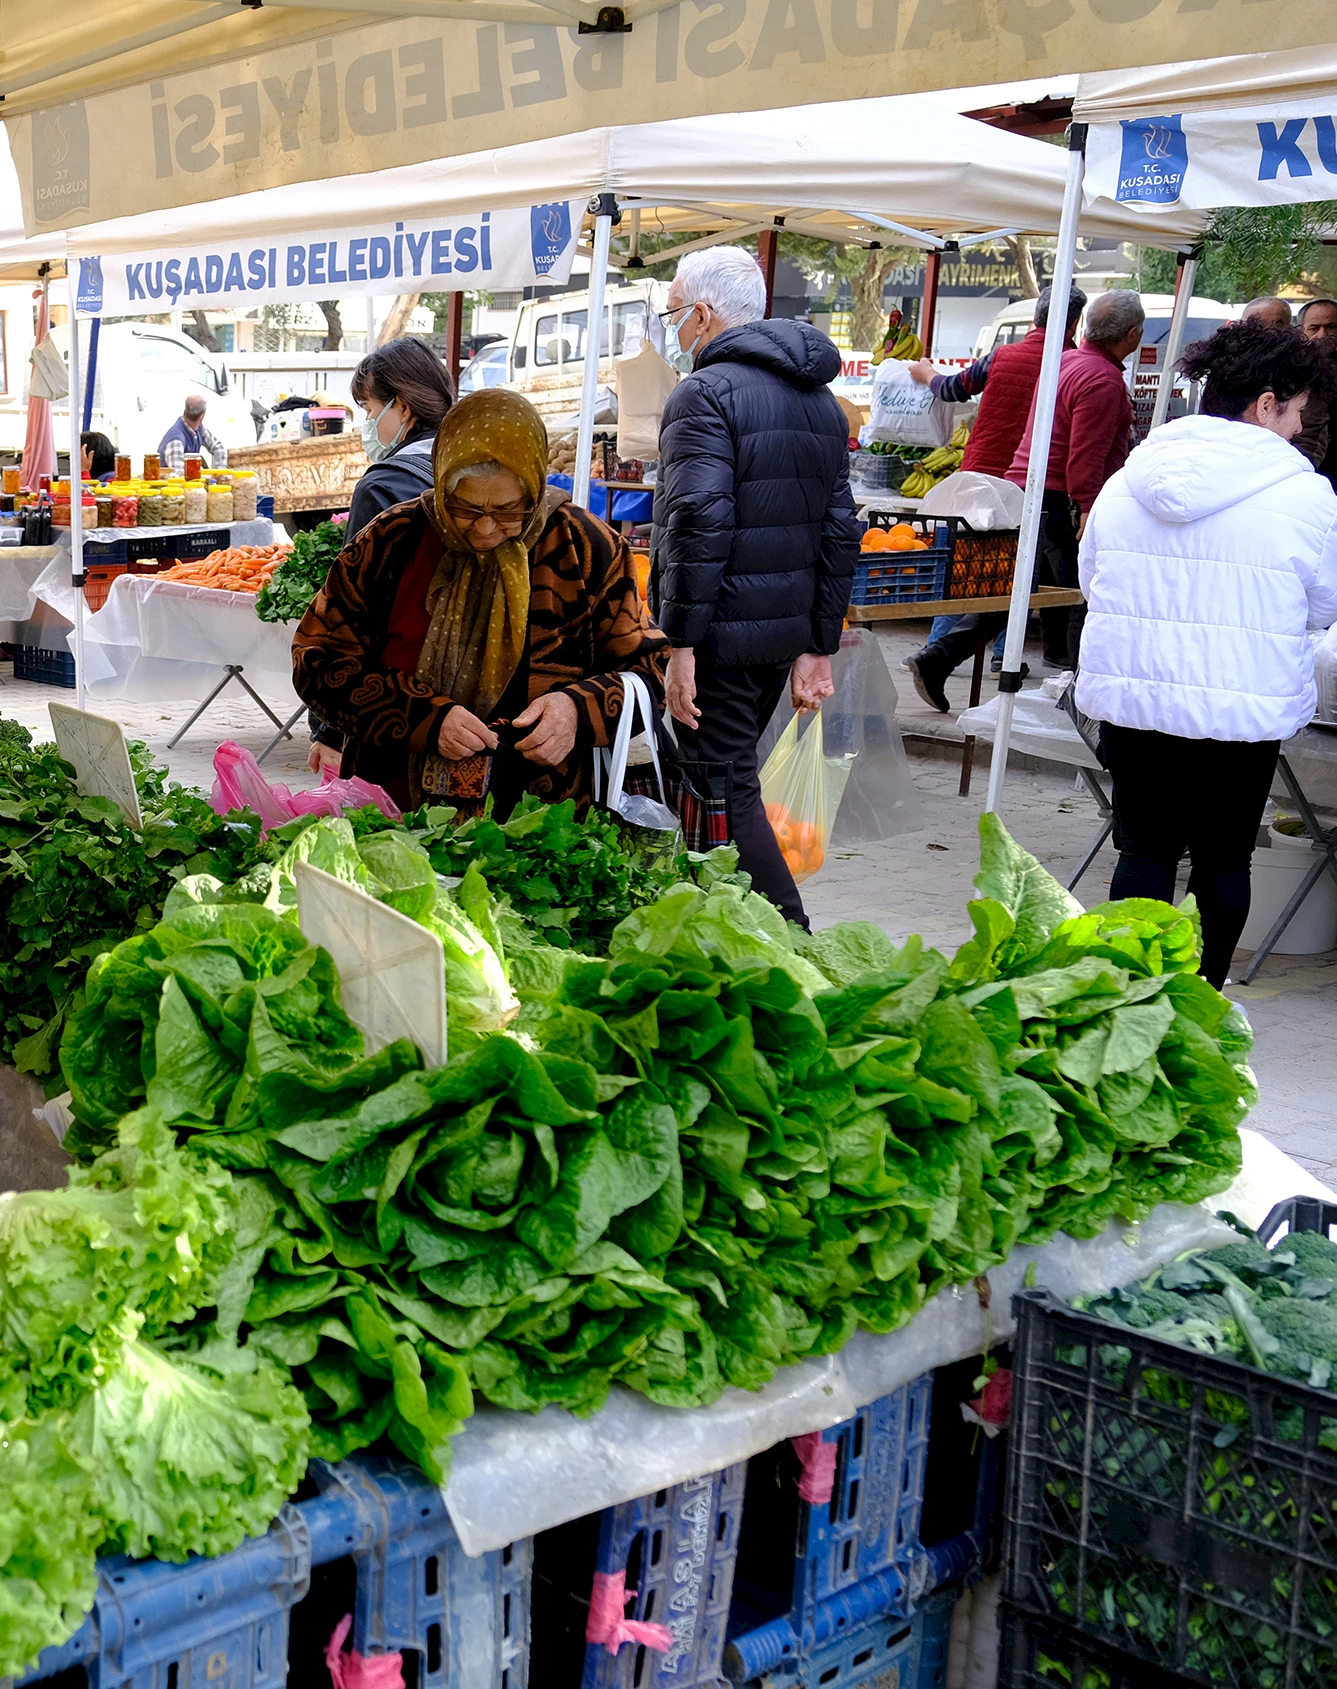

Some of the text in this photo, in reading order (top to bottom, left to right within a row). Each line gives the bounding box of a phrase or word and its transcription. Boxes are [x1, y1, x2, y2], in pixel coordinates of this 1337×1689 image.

[1143, 163, 1161, 173] T.C.
[125, 212, 493, 306] KUŞADASI BELEDİYESİ
